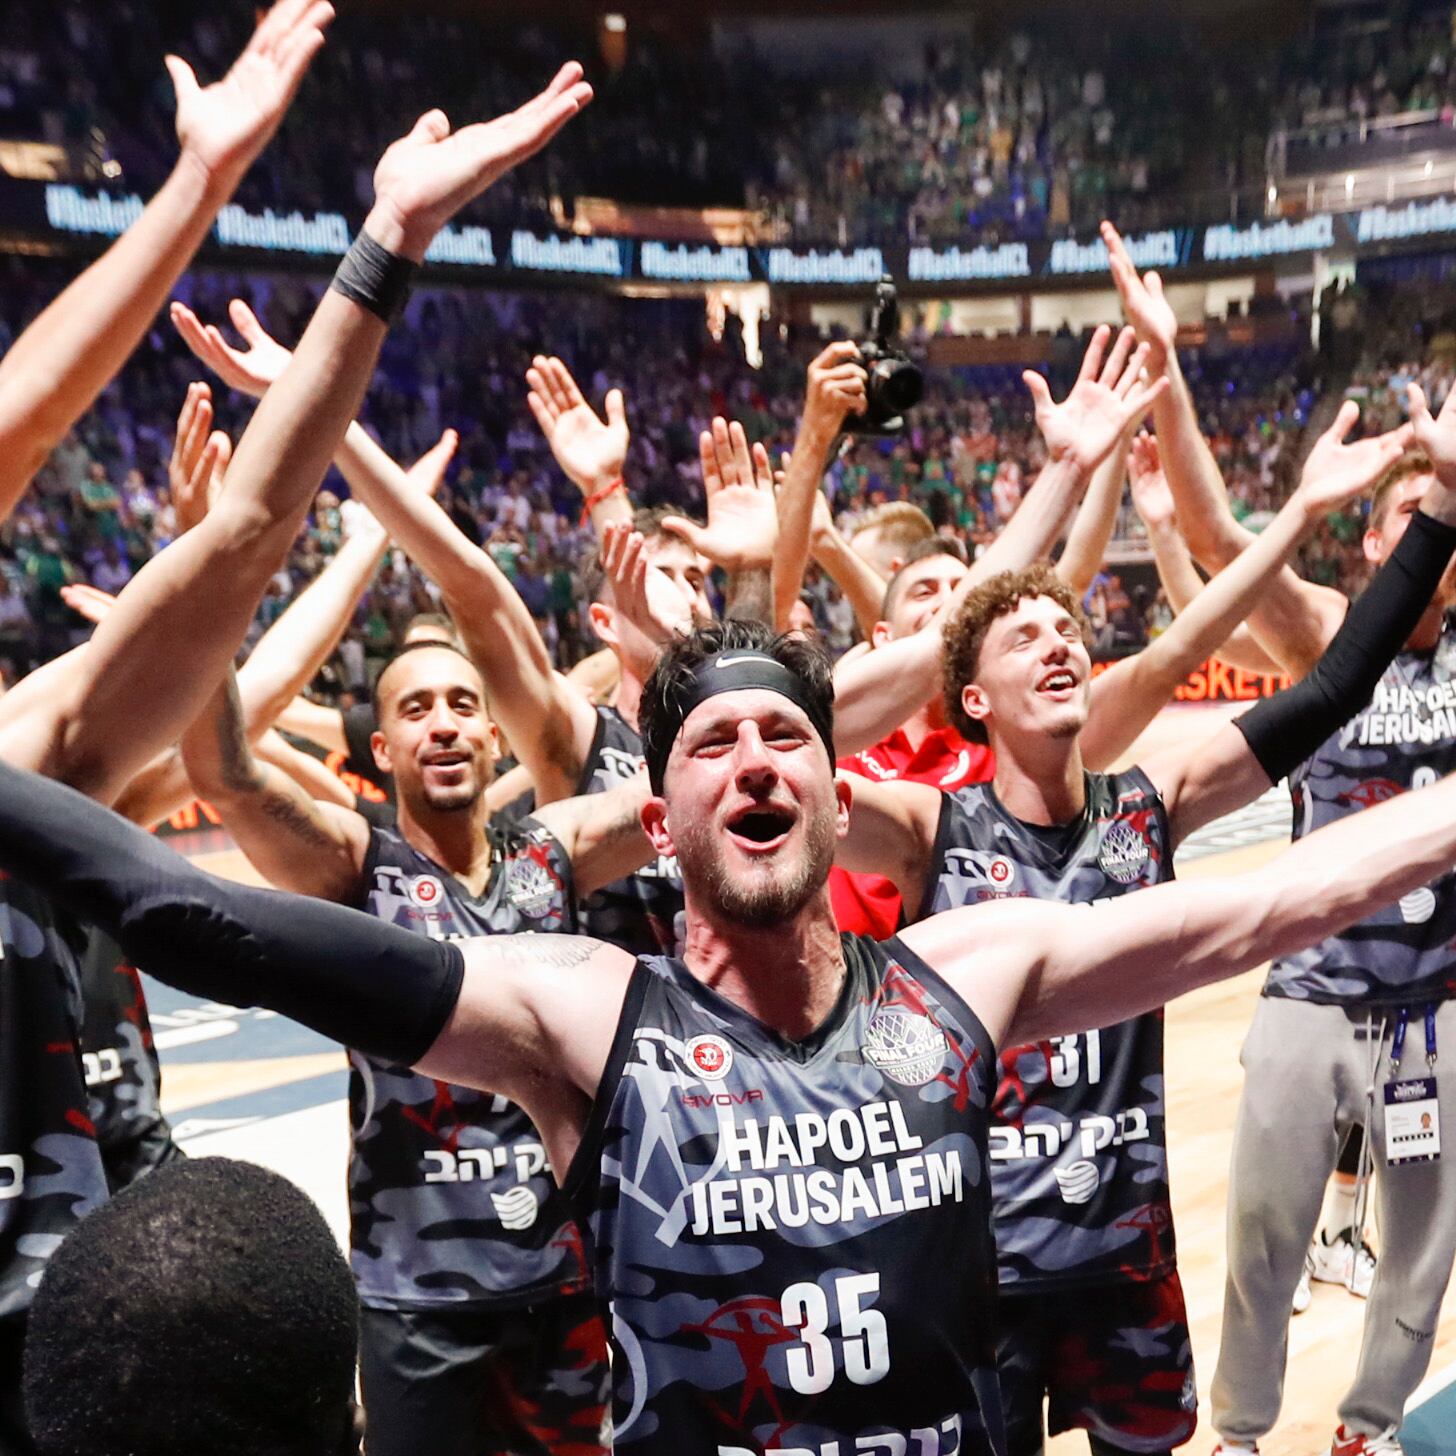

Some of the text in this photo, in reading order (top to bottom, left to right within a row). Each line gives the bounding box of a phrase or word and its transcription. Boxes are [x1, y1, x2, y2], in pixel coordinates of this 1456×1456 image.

[906, 1033, 945, 1058] FOUR
[1049, 1028, 1101, 1088] 31
[681, 1088, 765, 1109] GIVOVA
[721, 1100, 924, 1173] HAPOEL
[989, 1121, 1073, 1160] יהב
[423, 1145, 508, 1183] יהב
[691, 1150, 964, 1237] JERUSALEM
[780, 1271, 891, 1395] 35
